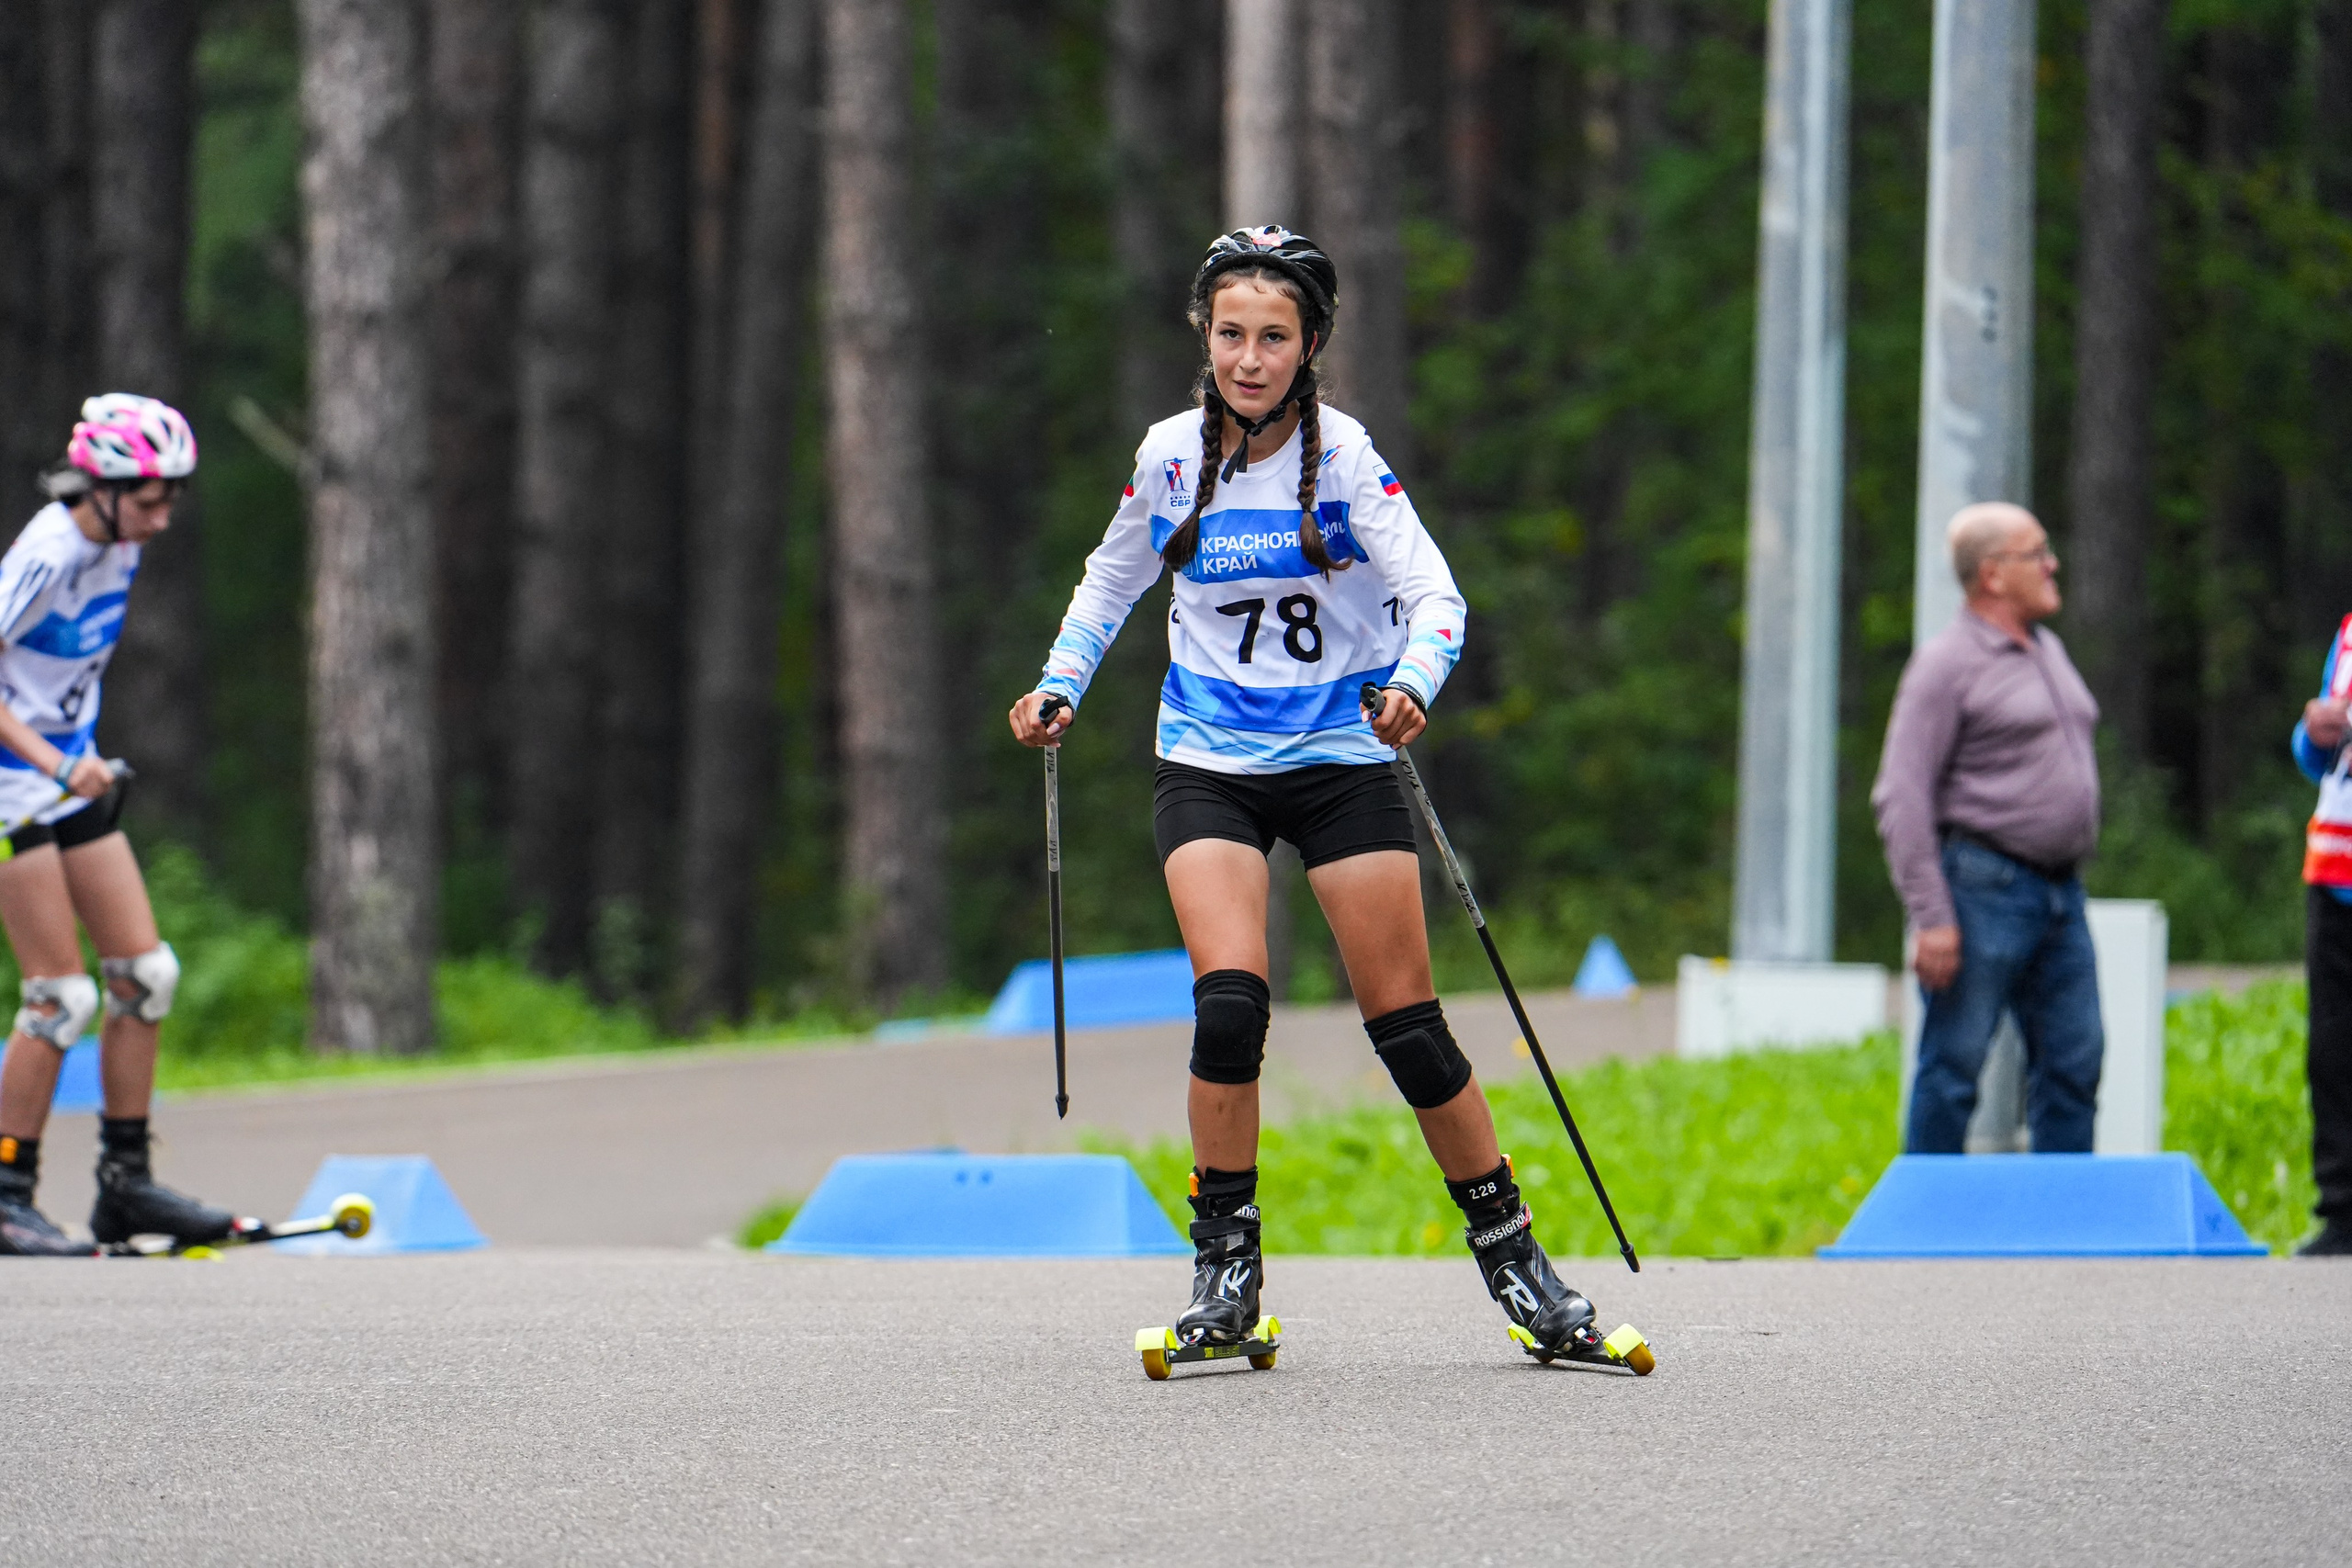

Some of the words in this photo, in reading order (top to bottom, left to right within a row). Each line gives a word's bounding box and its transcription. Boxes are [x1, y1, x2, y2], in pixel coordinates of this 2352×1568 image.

[1170, 499, 1191, 508] СБР
[1202, 551, 1258, 575] КРАЙ
[1215, 592, 1322, 664] 78
